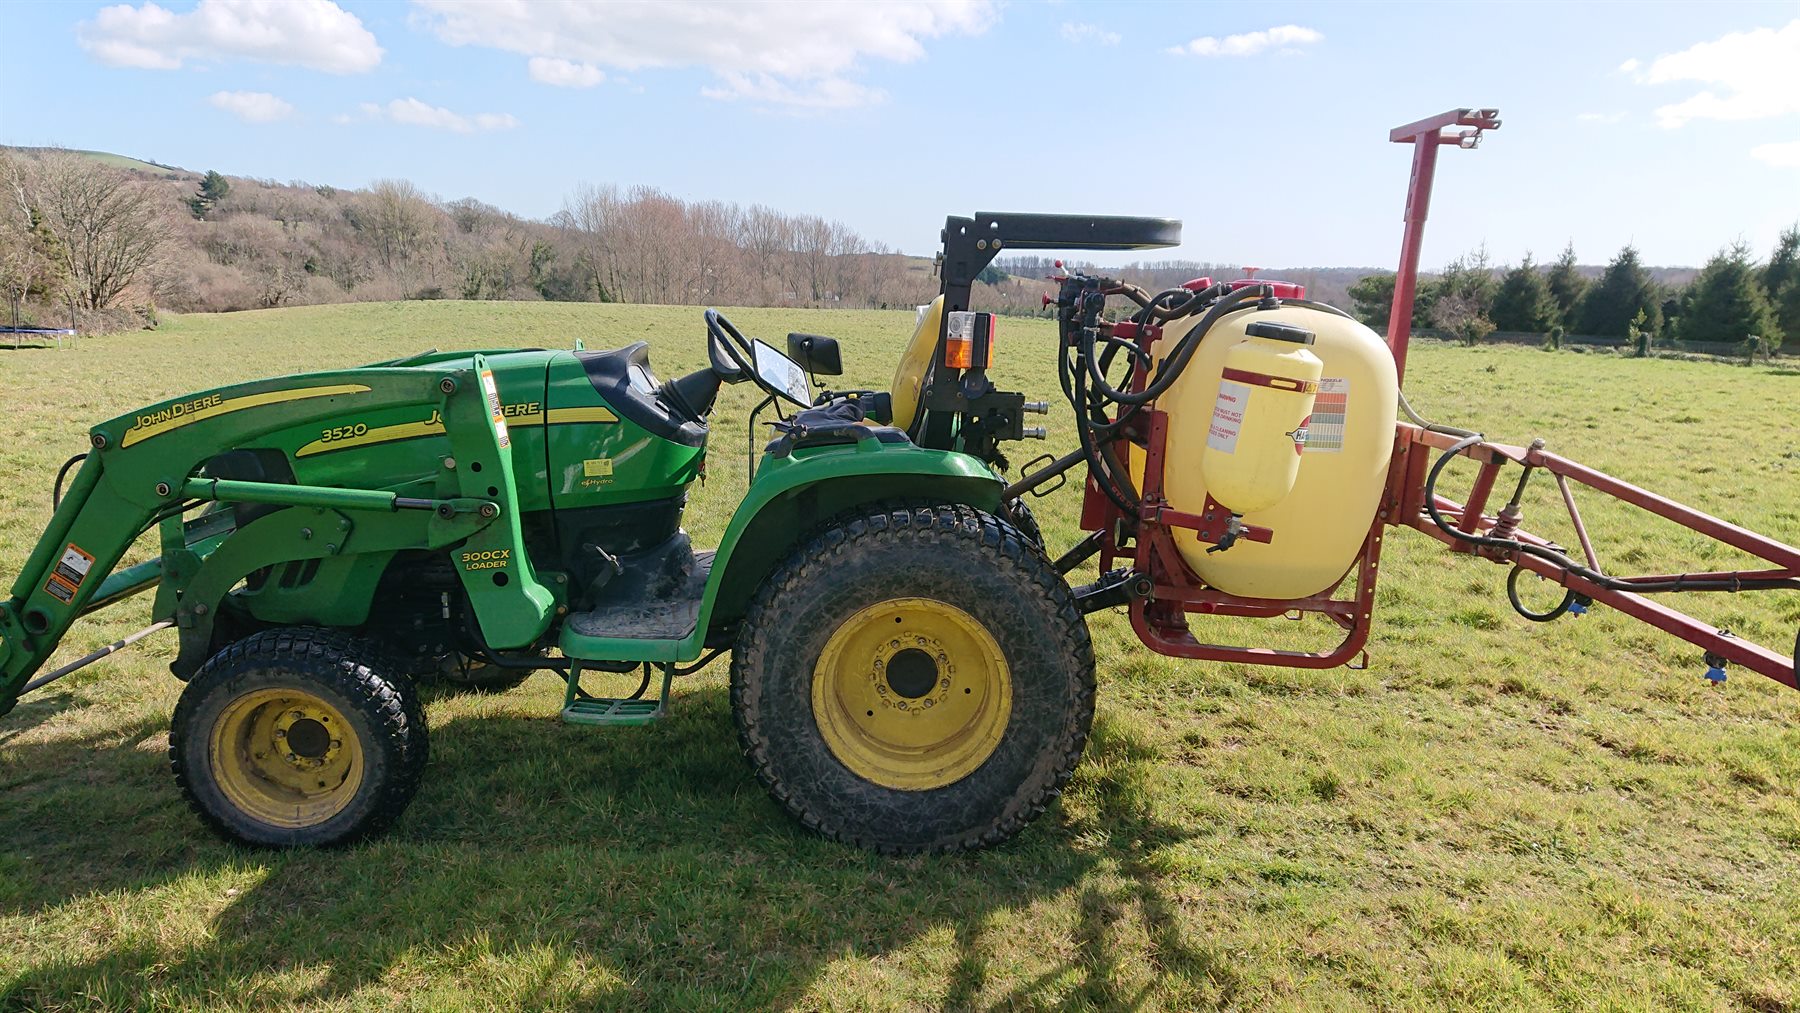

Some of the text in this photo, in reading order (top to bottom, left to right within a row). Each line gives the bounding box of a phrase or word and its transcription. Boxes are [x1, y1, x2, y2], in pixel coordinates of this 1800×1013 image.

[133, 393, 223, 430] JOHN DEERE
[1231, 410, 1242, 418] NOT
[321, 423, 367, 442] 3520
[462, 549, 510, 562] 300CX
[466, 560, 507, 571] LOADER
